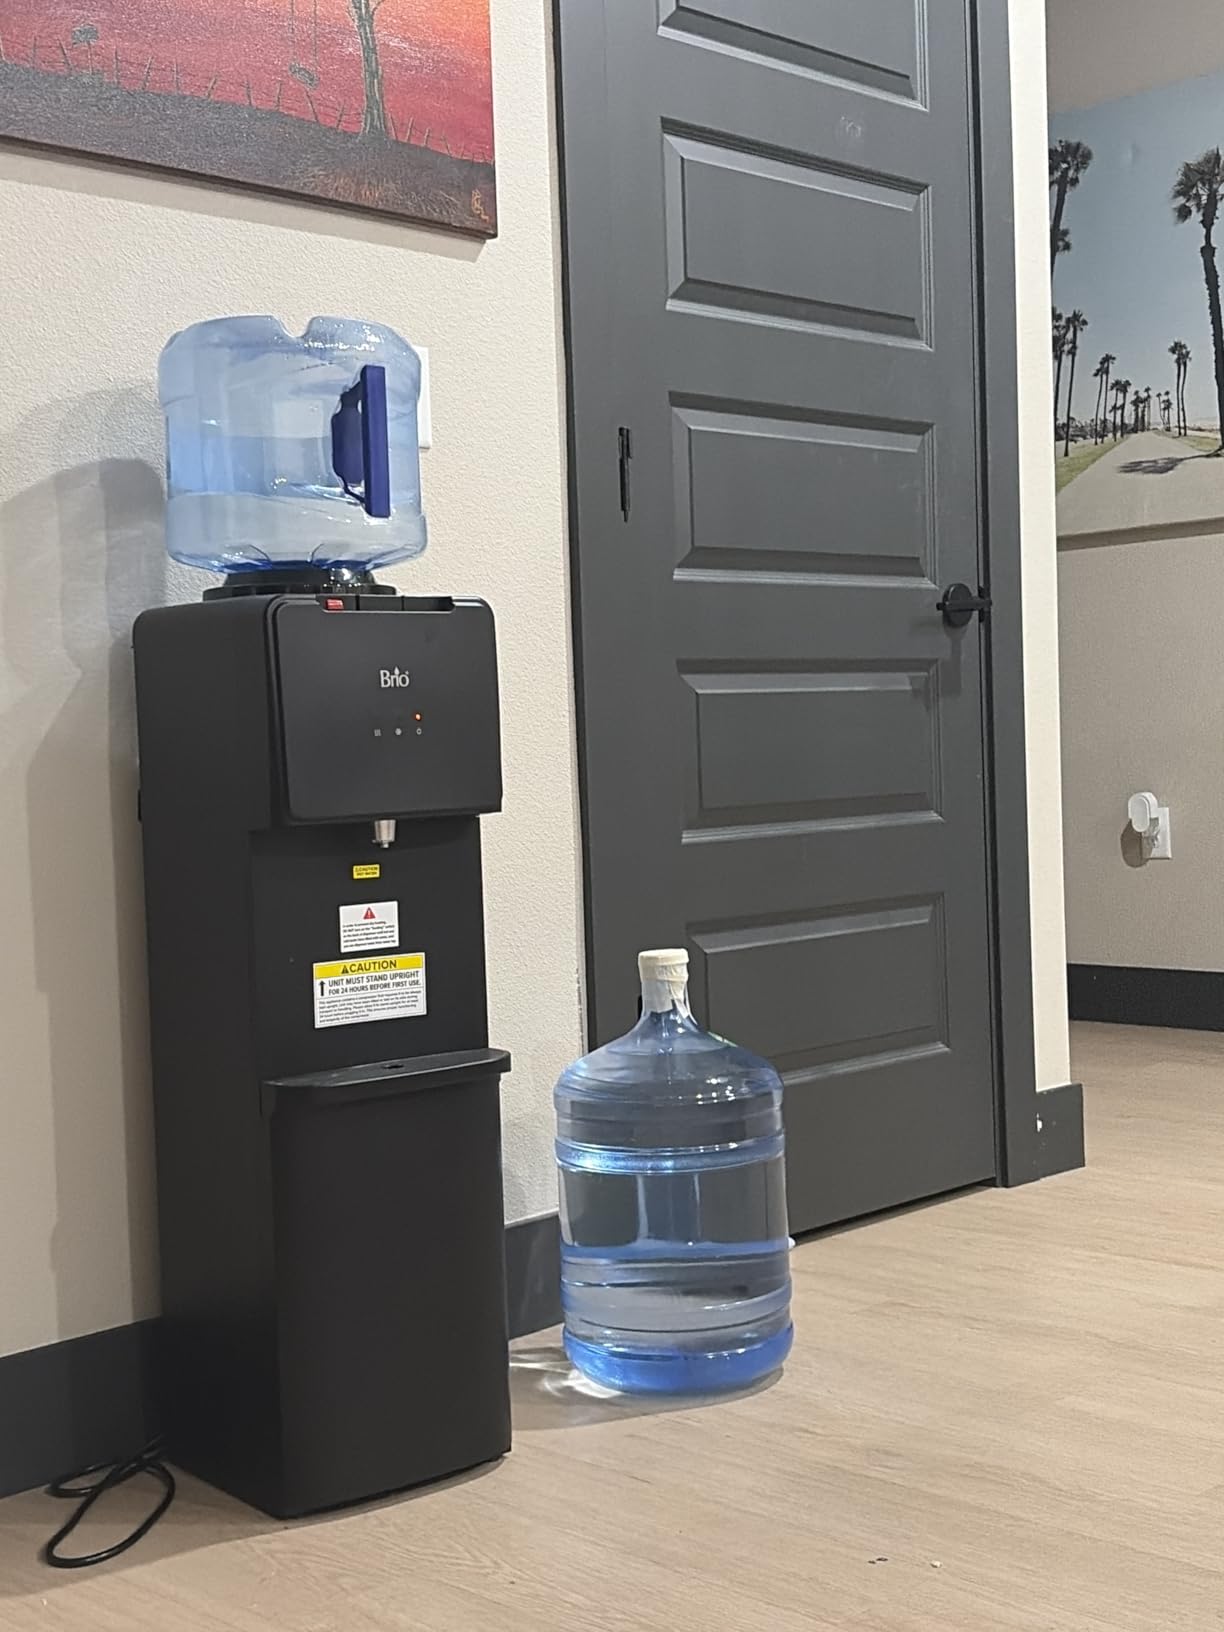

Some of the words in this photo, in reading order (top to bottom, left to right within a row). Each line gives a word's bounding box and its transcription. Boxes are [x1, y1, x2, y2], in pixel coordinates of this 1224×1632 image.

[380, 666, 410, 688] Brio
[350, 960, 397, 973] CAUTION
[328, 979, 344, 987] UNIT
[346, 976, 364, 985] MUST
[366, 974, 388, 982] STAND
[390, 970, 419, 980] UPRIGHT
[328, 987, 340, 995] FOR
[349, 984, 369, 993] HOURS
[370, 982, 391, 990] BEFORE
[392, 980, 407, 988] FIRST
